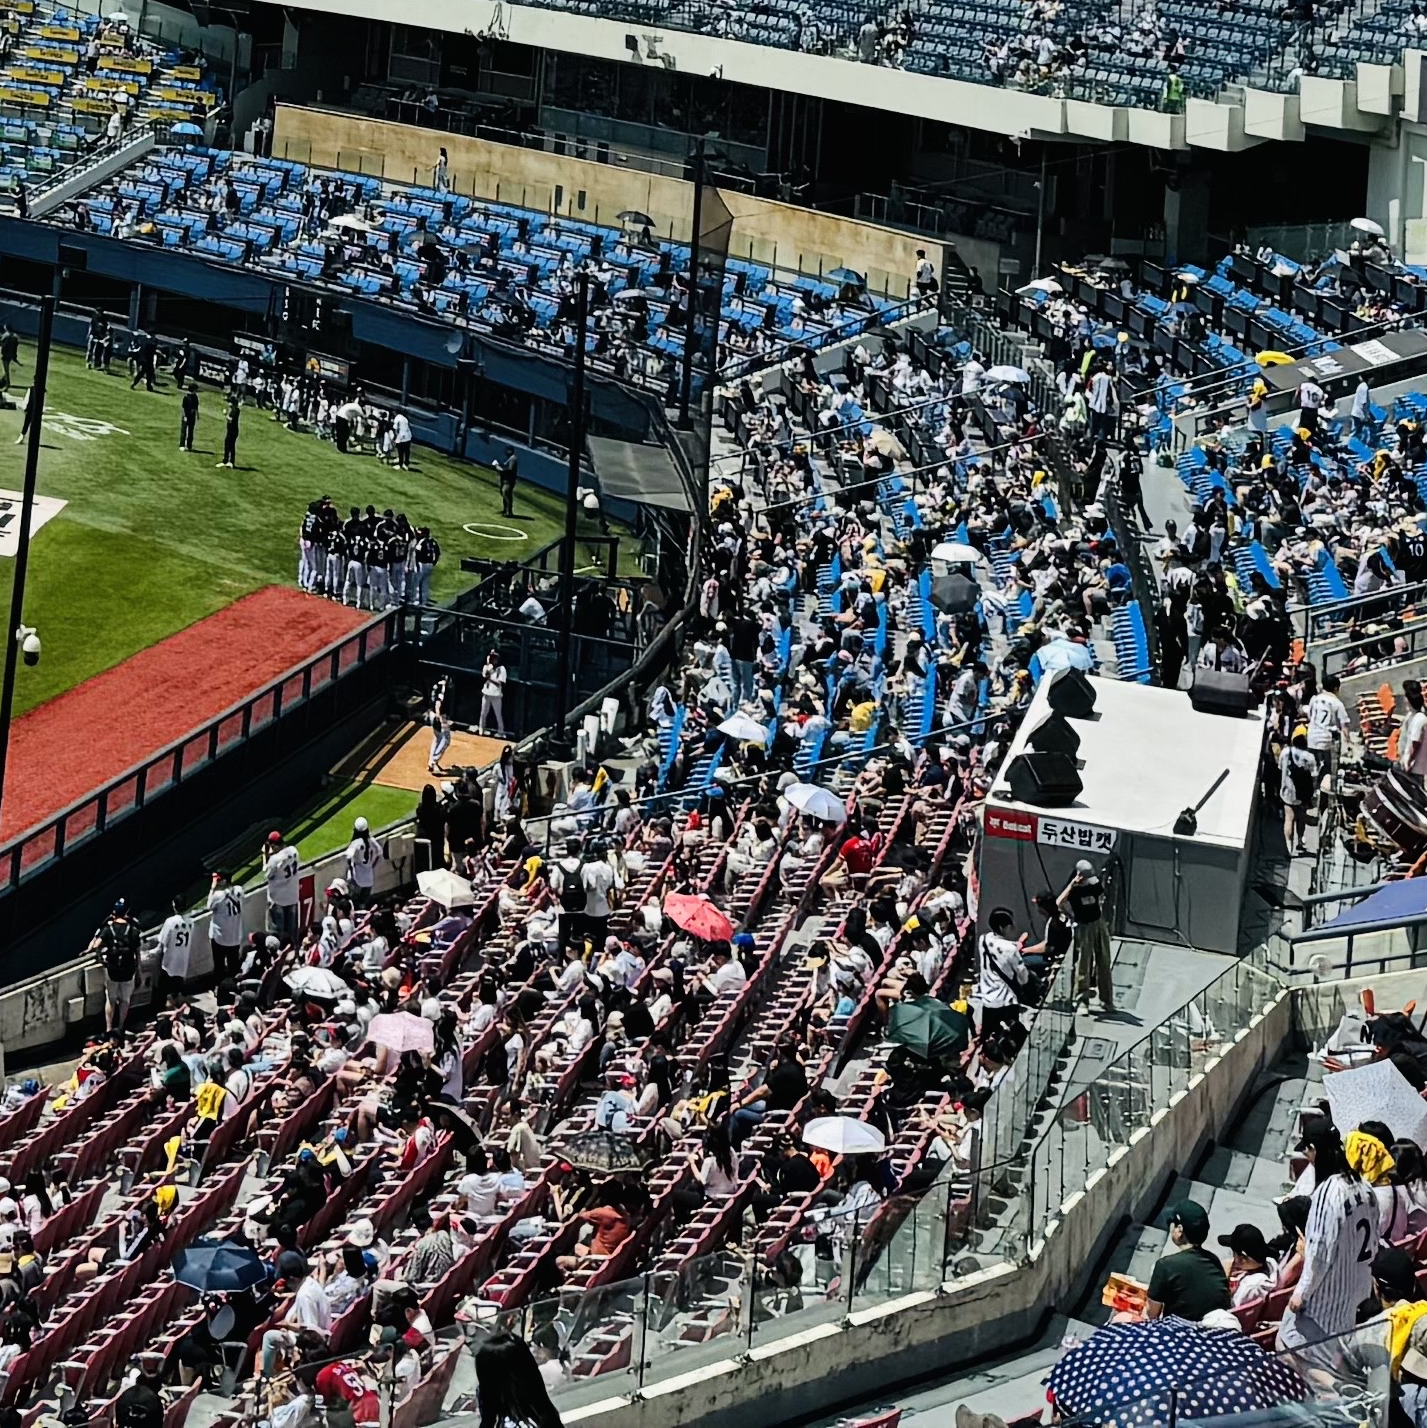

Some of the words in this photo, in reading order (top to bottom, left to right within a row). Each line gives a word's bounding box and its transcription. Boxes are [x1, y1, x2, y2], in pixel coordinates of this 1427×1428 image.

[1408, 543, 1425, 557] 10
[1041, 822, 1112, 851] 두산밥캣
[174, 931, 190, 947] 51
